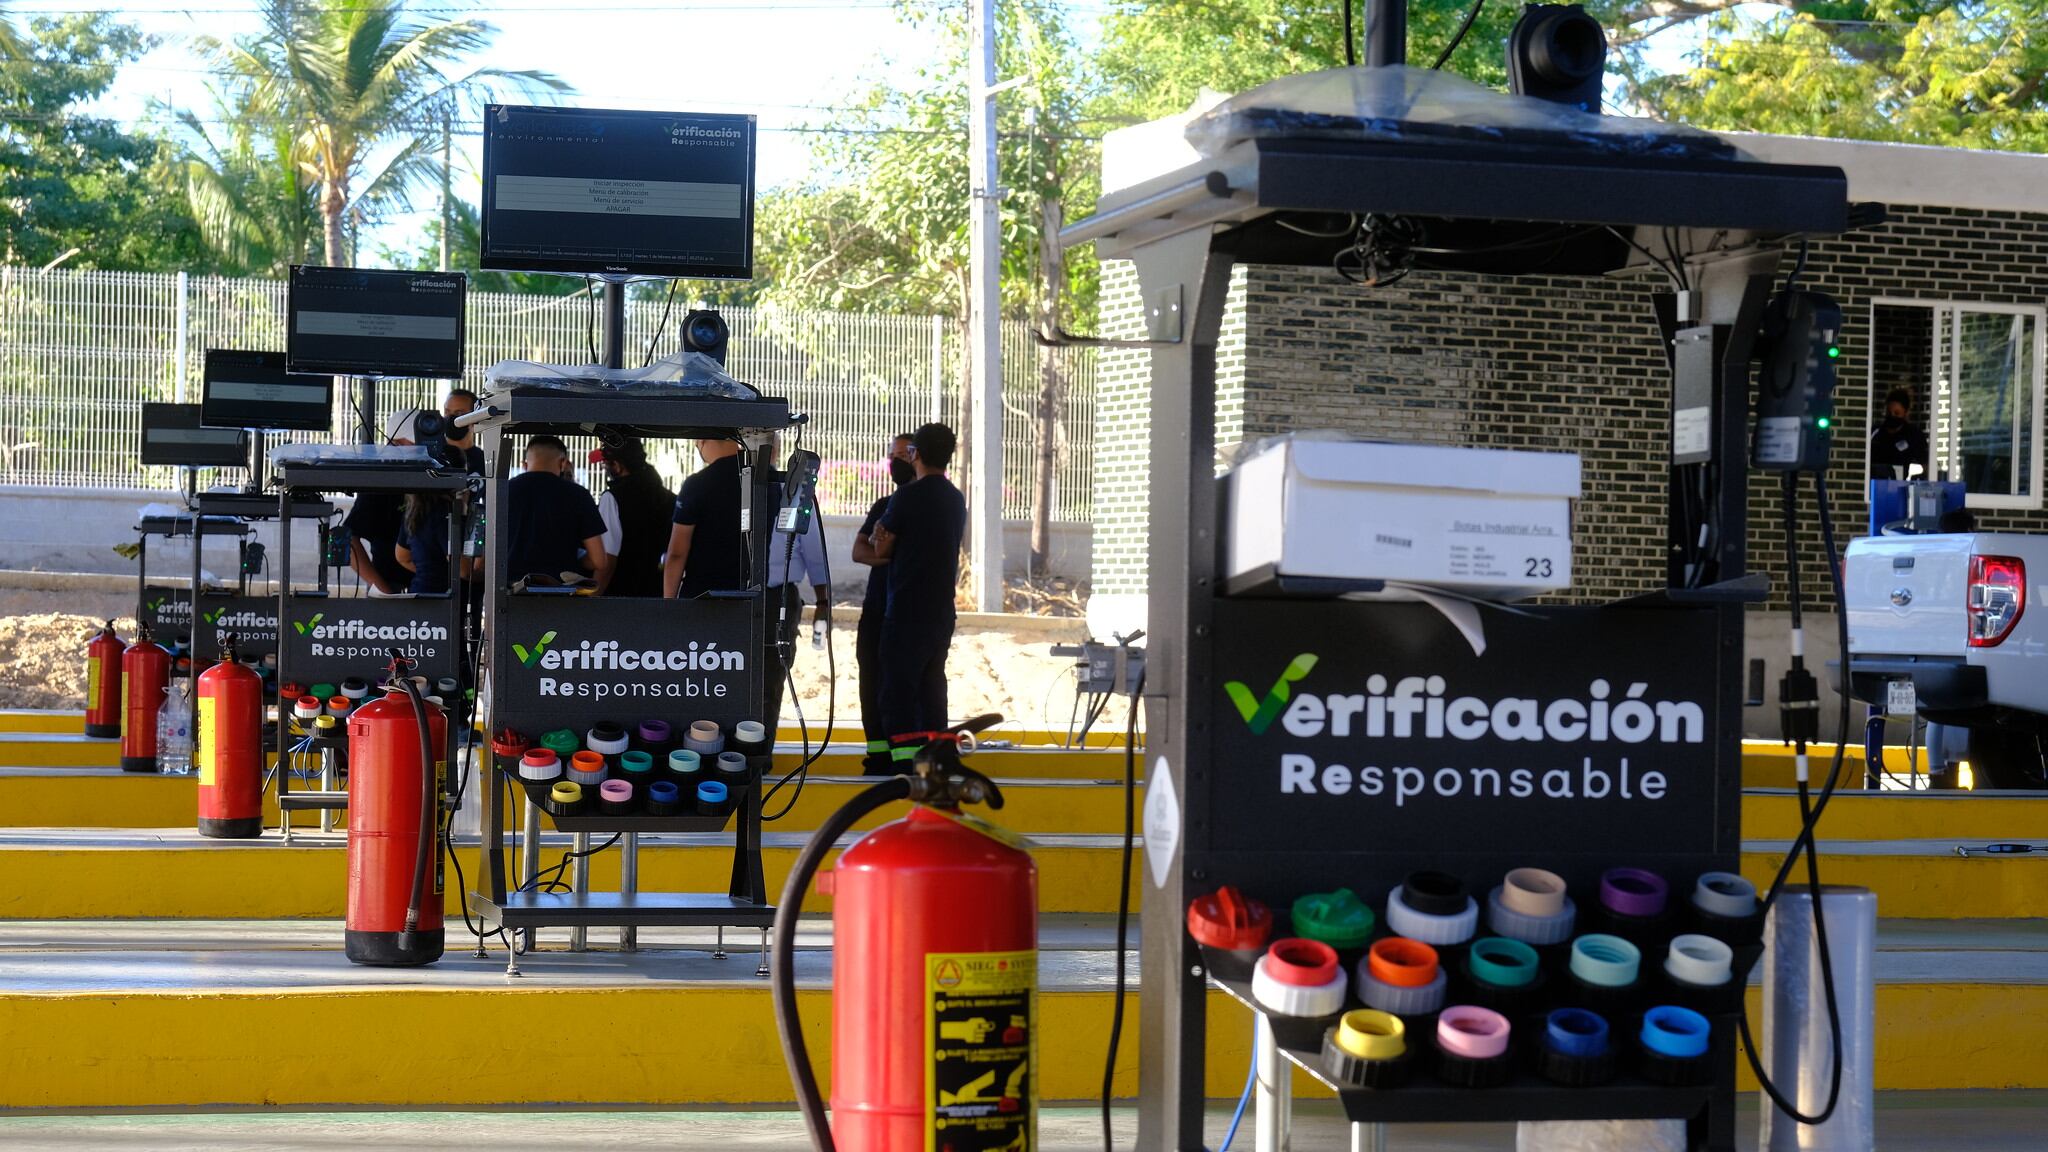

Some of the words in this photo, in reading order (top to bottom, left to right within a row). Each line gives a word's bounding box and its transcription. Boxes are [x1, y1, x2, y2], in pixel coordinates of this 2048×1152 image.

[1525, 557, 1553, 578] 23
[293, 613, 448, 641] Verificación
[512, 630, 745, 671] Verificación
[539, 677, 727, 702] Responsable
[1224, 653, 1705, 743] Verificación
[1280, 753, 1668, 807] Responsable
